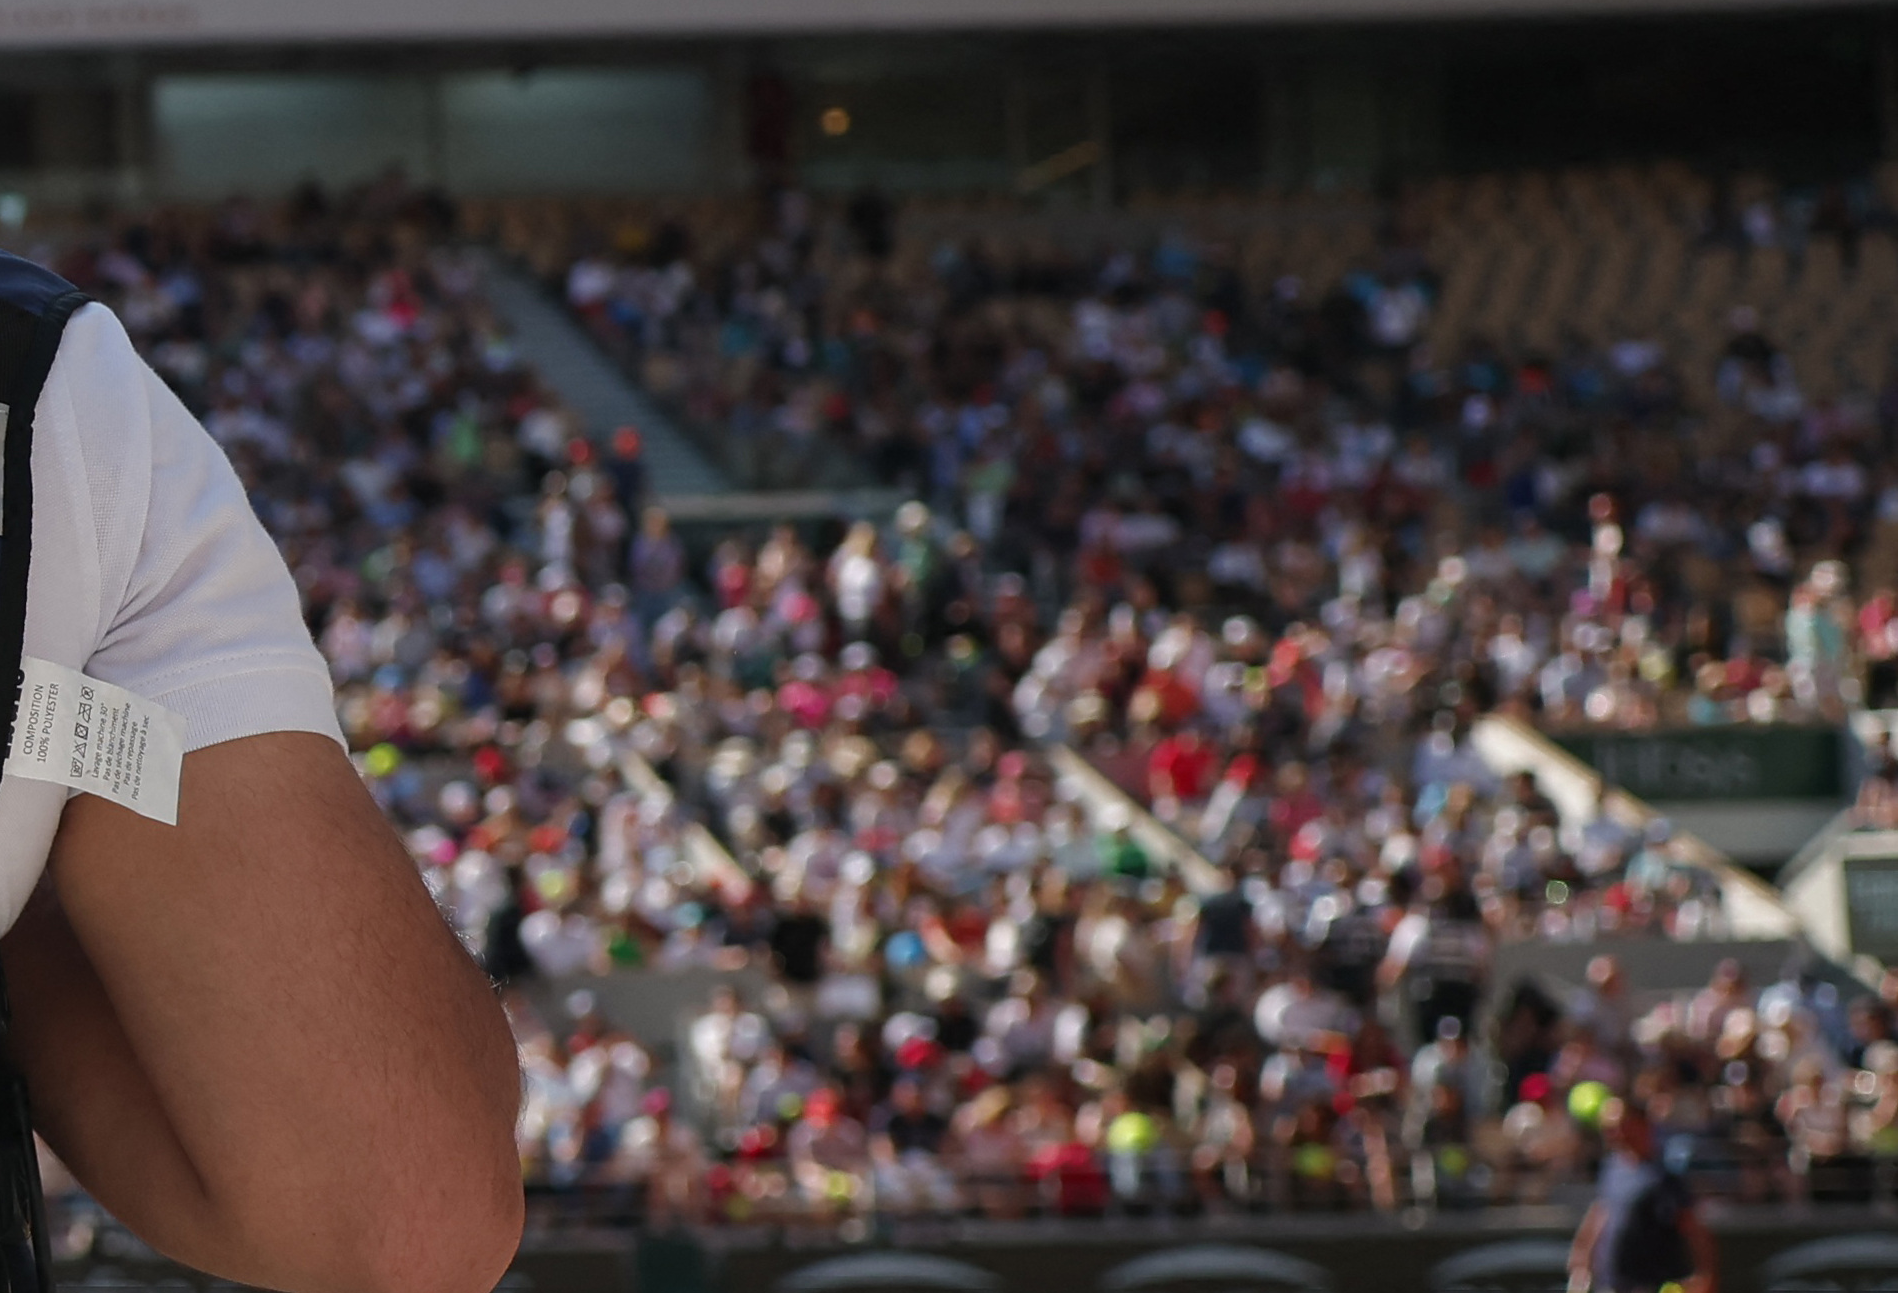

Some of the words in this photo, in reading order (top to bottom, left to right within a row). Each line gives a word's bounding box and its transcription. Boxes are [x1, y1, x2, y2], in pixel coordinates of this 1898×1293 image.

[23, 684, 44, 755] COMPOSITION
[42, 683, 59, 735] POLYESTER
[96, 718, 107, 751] machine
[36, 737, 50, 763] 100%
[91, 752, 104, 778] Lavage
[103, 768, 111, 781] Pas
[112, 780, 120, 794] Pas
